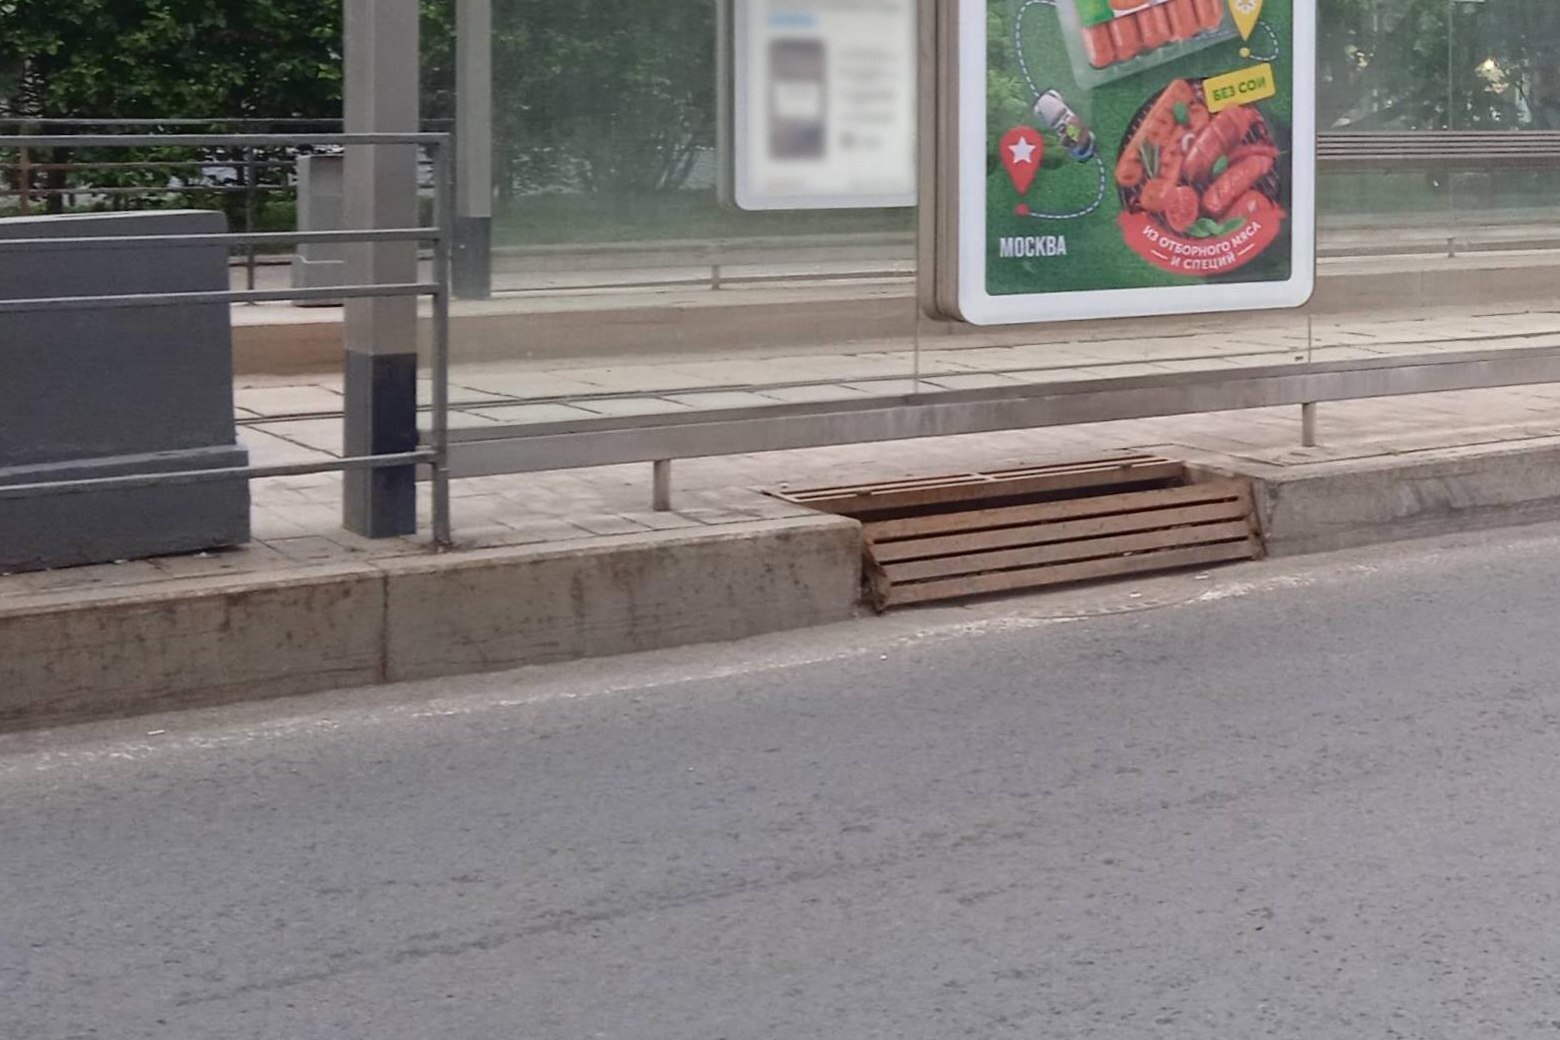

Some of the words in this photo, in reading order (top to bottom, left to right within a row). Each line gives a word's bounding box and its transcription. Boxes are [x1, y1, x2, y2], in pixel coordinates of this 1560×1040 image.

[1212, 85, 1236, 101] БЕЗ
[1238, 76, 1266, 93] СОИ
[1000, 235, 1067, 258] МОСКВА
[1142, 225, 1159, 242] ИЗ
[1159, 236, 1232, 256] ОТБОРНОГО
[1231, 221, 1263, 248] МЯСА
[1170, 256, 1180, 267] И
[1183, 252, 1237, 270] СПЕЦИЙ
